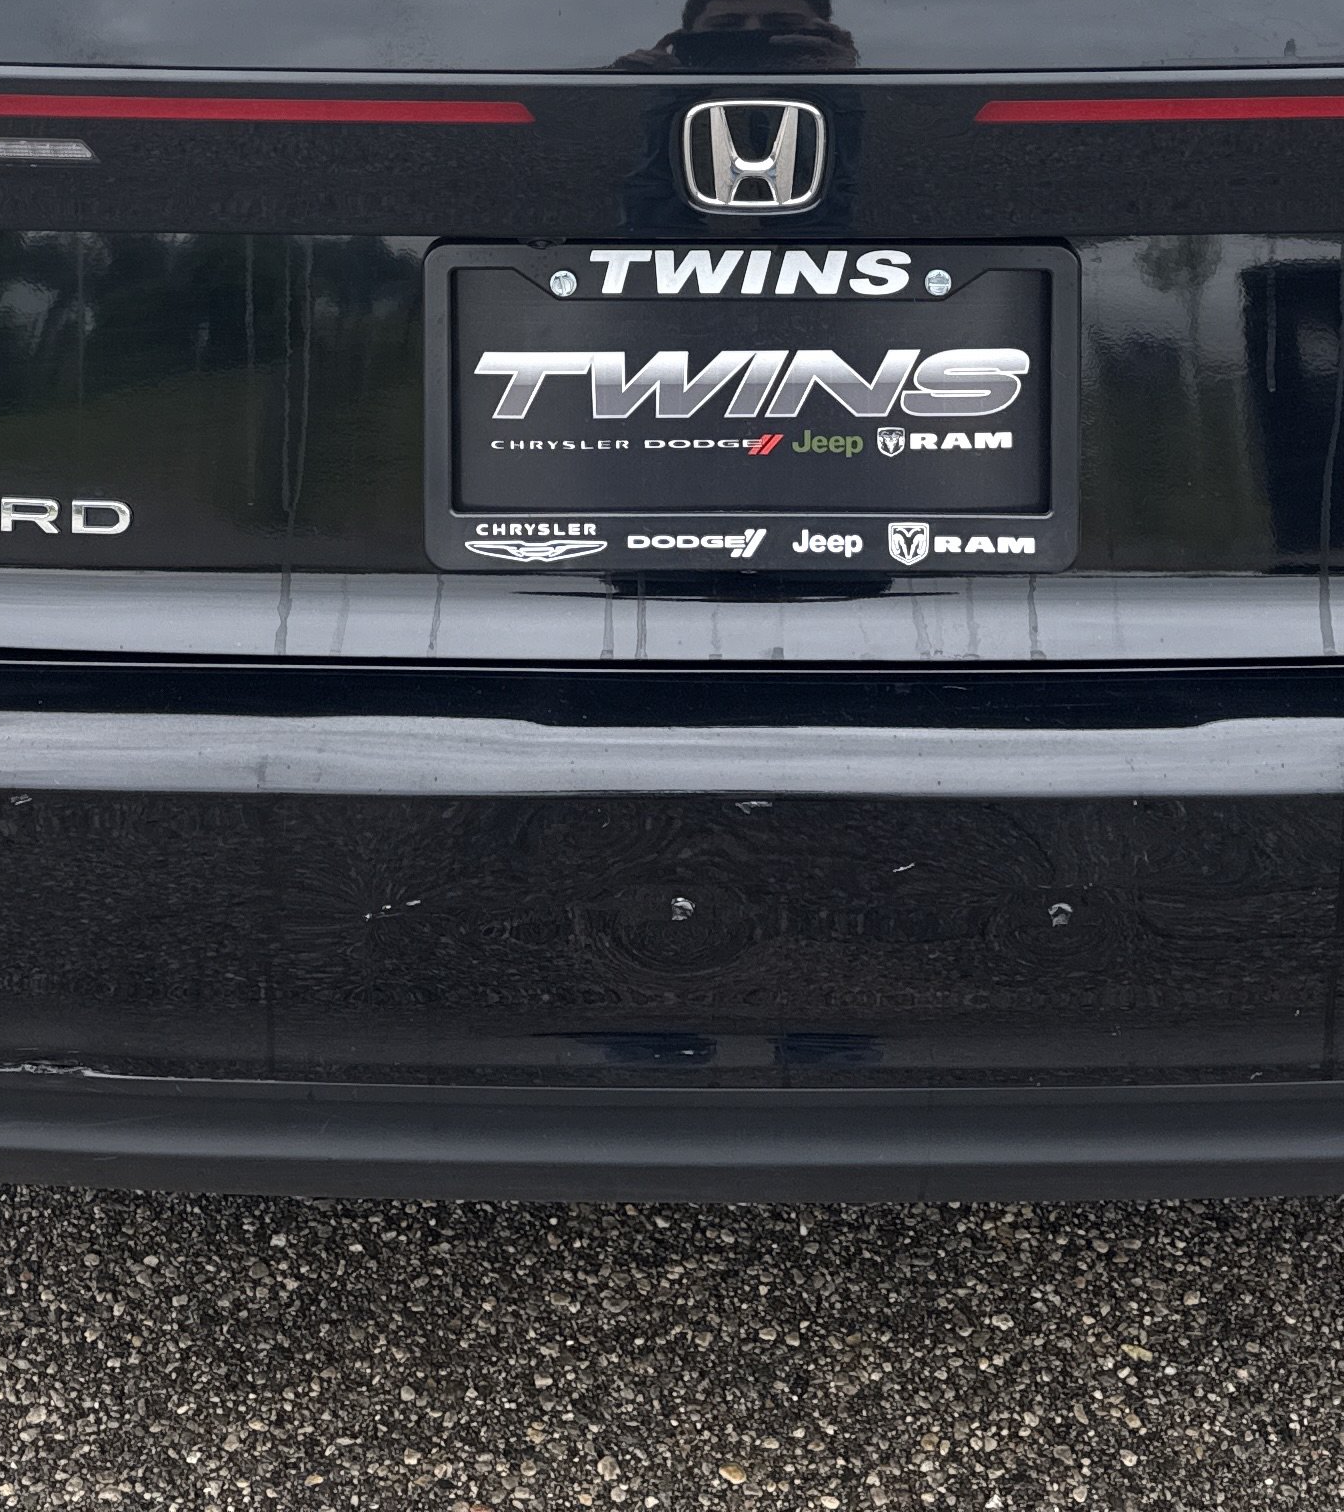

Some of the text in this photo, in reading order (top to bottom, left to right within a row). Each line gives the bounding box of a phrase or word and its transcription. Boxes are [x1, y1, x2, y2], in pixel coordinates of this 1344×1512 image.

[590, 250, 911, 295] TWINS
[474, 349, 1029, 419] TWINS
[491, 430, 1012, 457] CHRYSLER DODGE Jeep RAM
[476, 523, 1035, 558] CHRYSLER DODGE Jeep RAM
